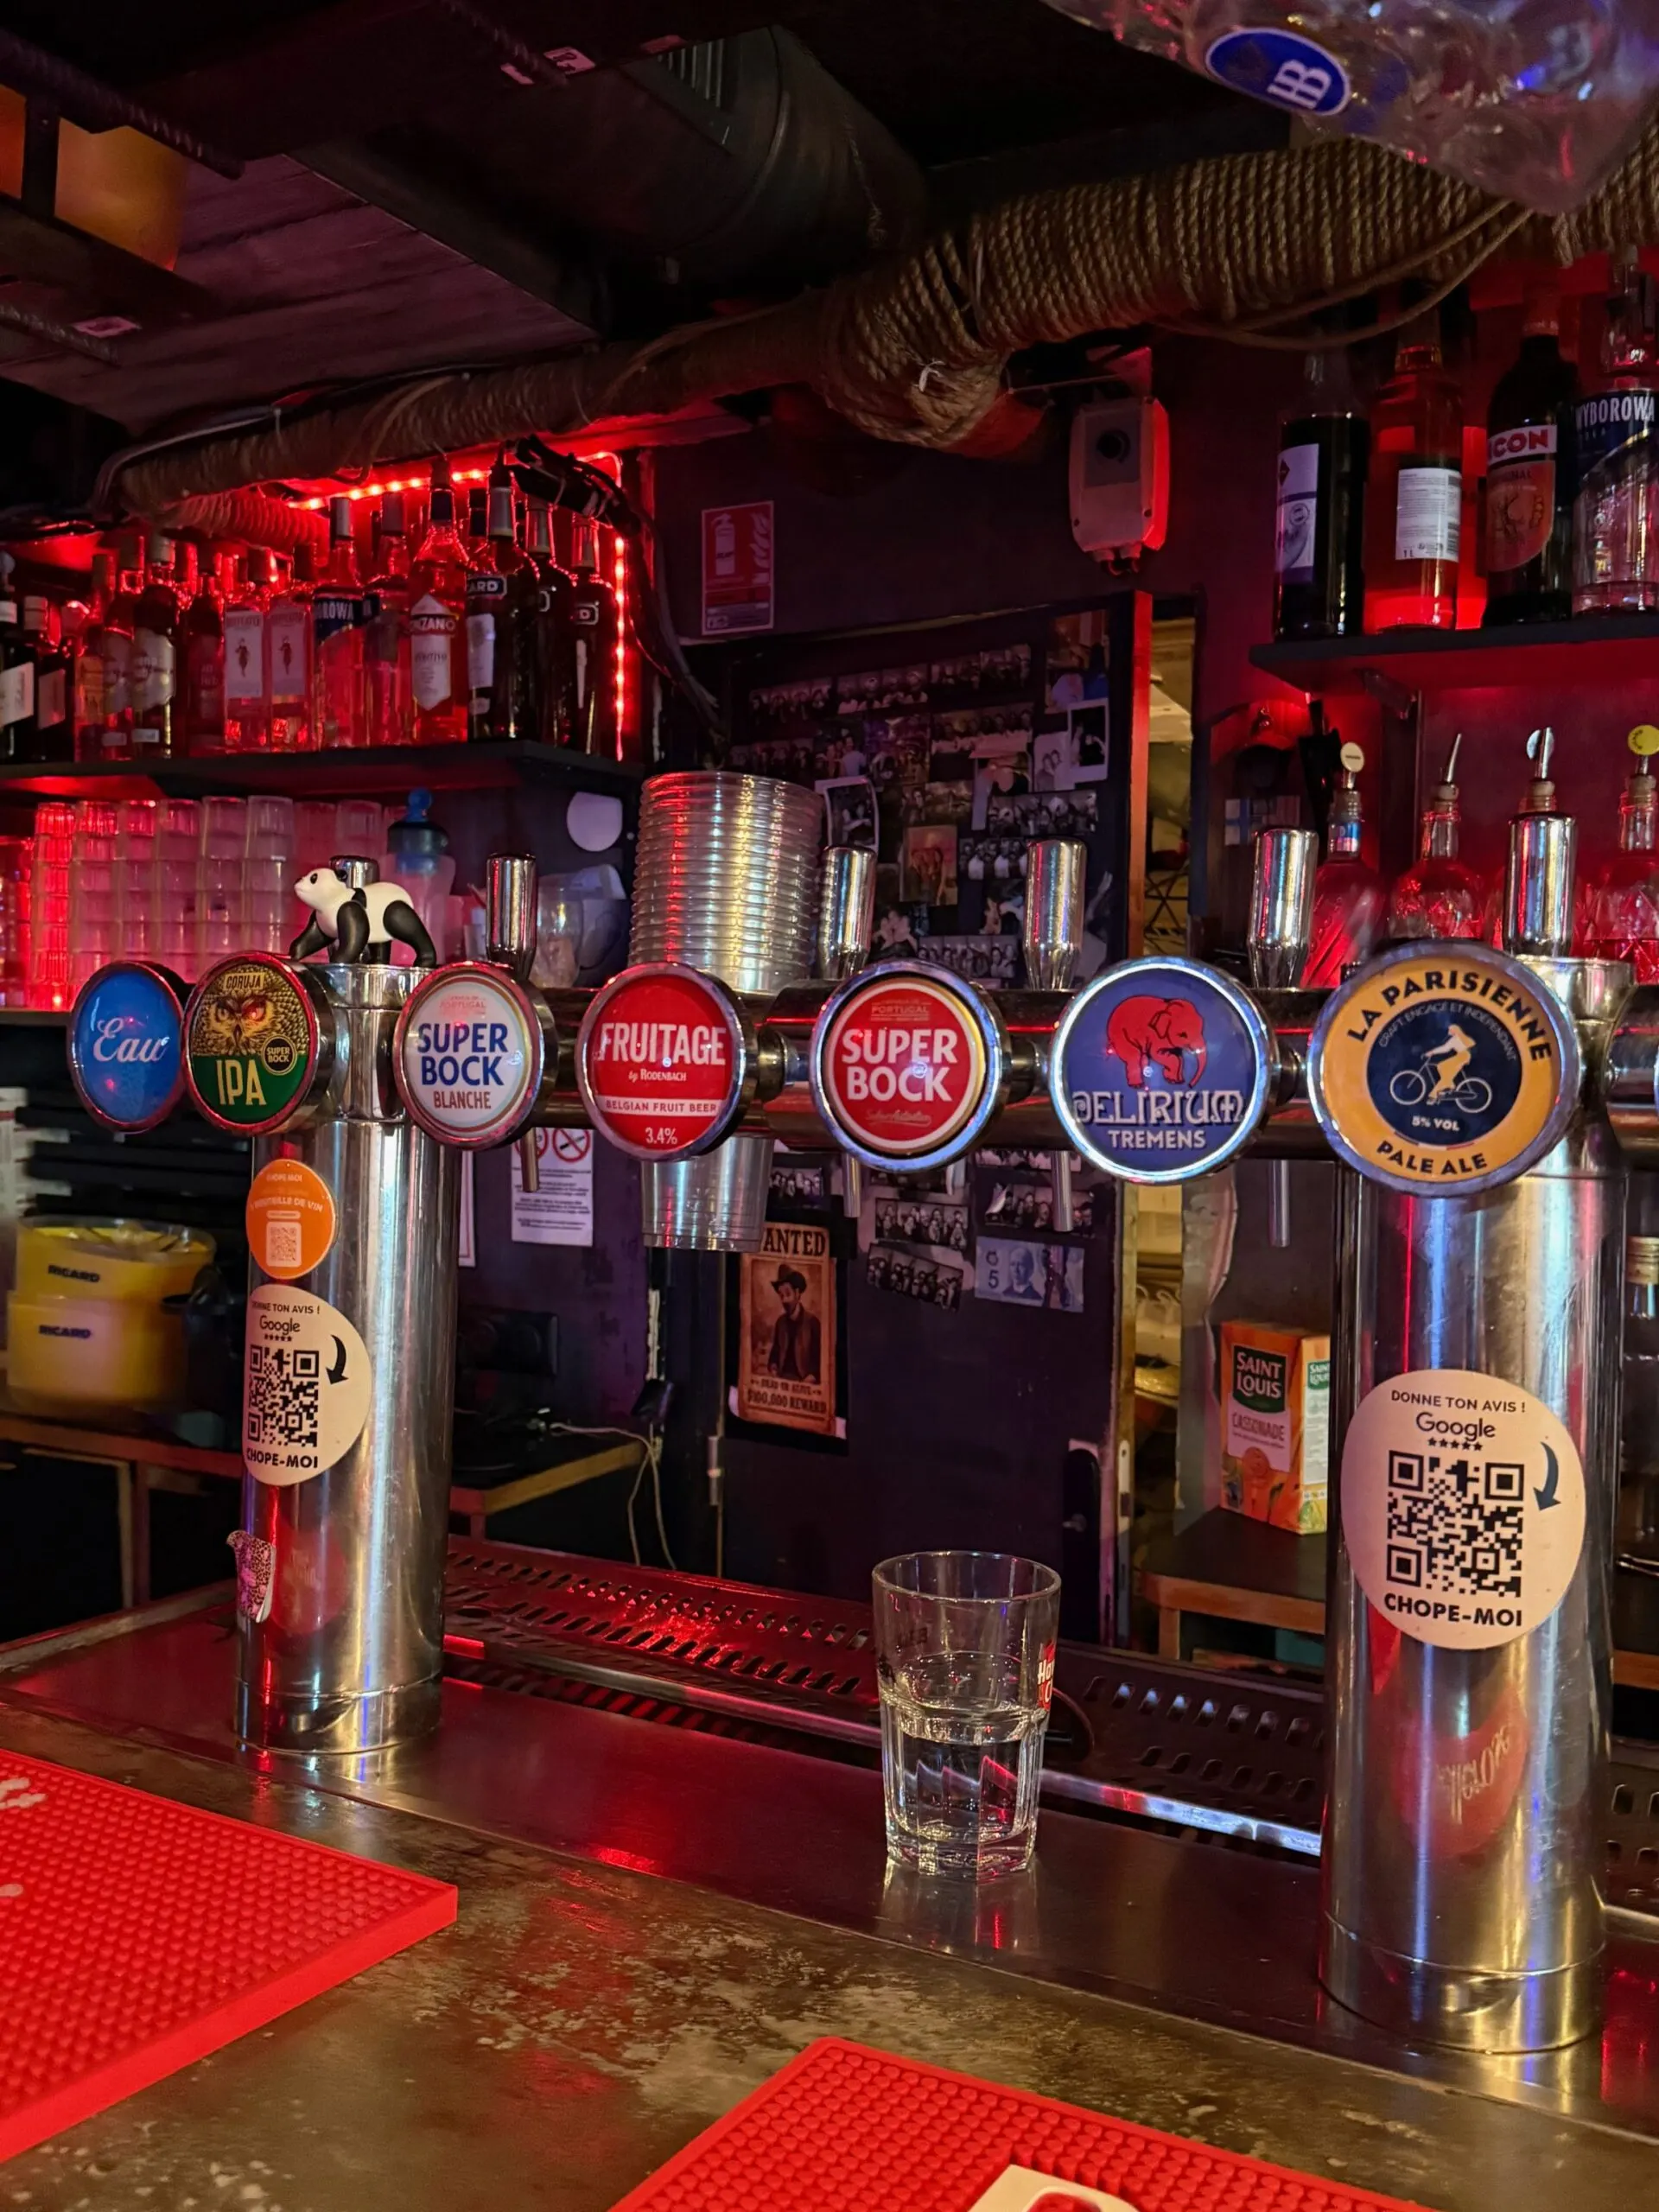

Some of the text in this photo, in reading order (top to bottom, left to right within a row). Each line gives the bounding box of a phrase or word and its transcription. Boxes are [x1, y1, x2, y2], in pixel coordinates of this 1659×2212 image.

[226, 976, 261, 988] CORUJA
[1347, 970, 1553, 1061] LA PARISIENNE
[1378, 1018, 1404, 1047] CRAFT
[1450, 1002, 1462, 1012] ET
[92, 1017, 169, 1063] Eau
[417, 1022, 508, 1052] SUPER
[598, 1022, 727, 1065] FRUITAGE
[842, 1028, 958, 1065] SUPER
[266, 1046, 290, 1055] SUPER
[268, 1053, 289, 1063] BOCK
[216, 1059, 267, 1105] IPA
[422, 1056, 504, 1086] BOCK
[847, 1065, 952, 1102] BOCK
[433, 1090, 492, 1109] BLANCHE
[606, 1099, 717, 1114] BELGIAN FRUIT BEER
[1071, 1090, 1244, 1124] DELIRIUM
[645, 1127, 678, 1145] 3.4%
[1412, 1116, 1460, 1132] 5% VOL
[1107, 1130, 1206, 1149] TREMENS
[1376, 1140, 1488, 1175] PALE ALE
[763, 1227, 826, 1256] ANTED
[48, 1264, 101, 1283] RICARD
[272, 1303, 289, 1313] TON
[291, 1305, 314, 1314] AVIS
[39, 1325, 92, 1339] RICARD
[259, 1315, 301, 1335] Google
[1236, 1351, 1282, 1379] SAINT
[1236, 1374, 1282, 1398] LOUIS
[1391, 1389, 1441, 1407] DONNE
[1445, 1396, 1478, 1410] TON
[1482, 1400, 1516, 1413] AVIS
[1415, 1412, 1496, 1441] Google
[246, 1447, 318, 1469] CHOPE-MOI
[1384, 1593, 1522, 1626] CHOPE-MOI
